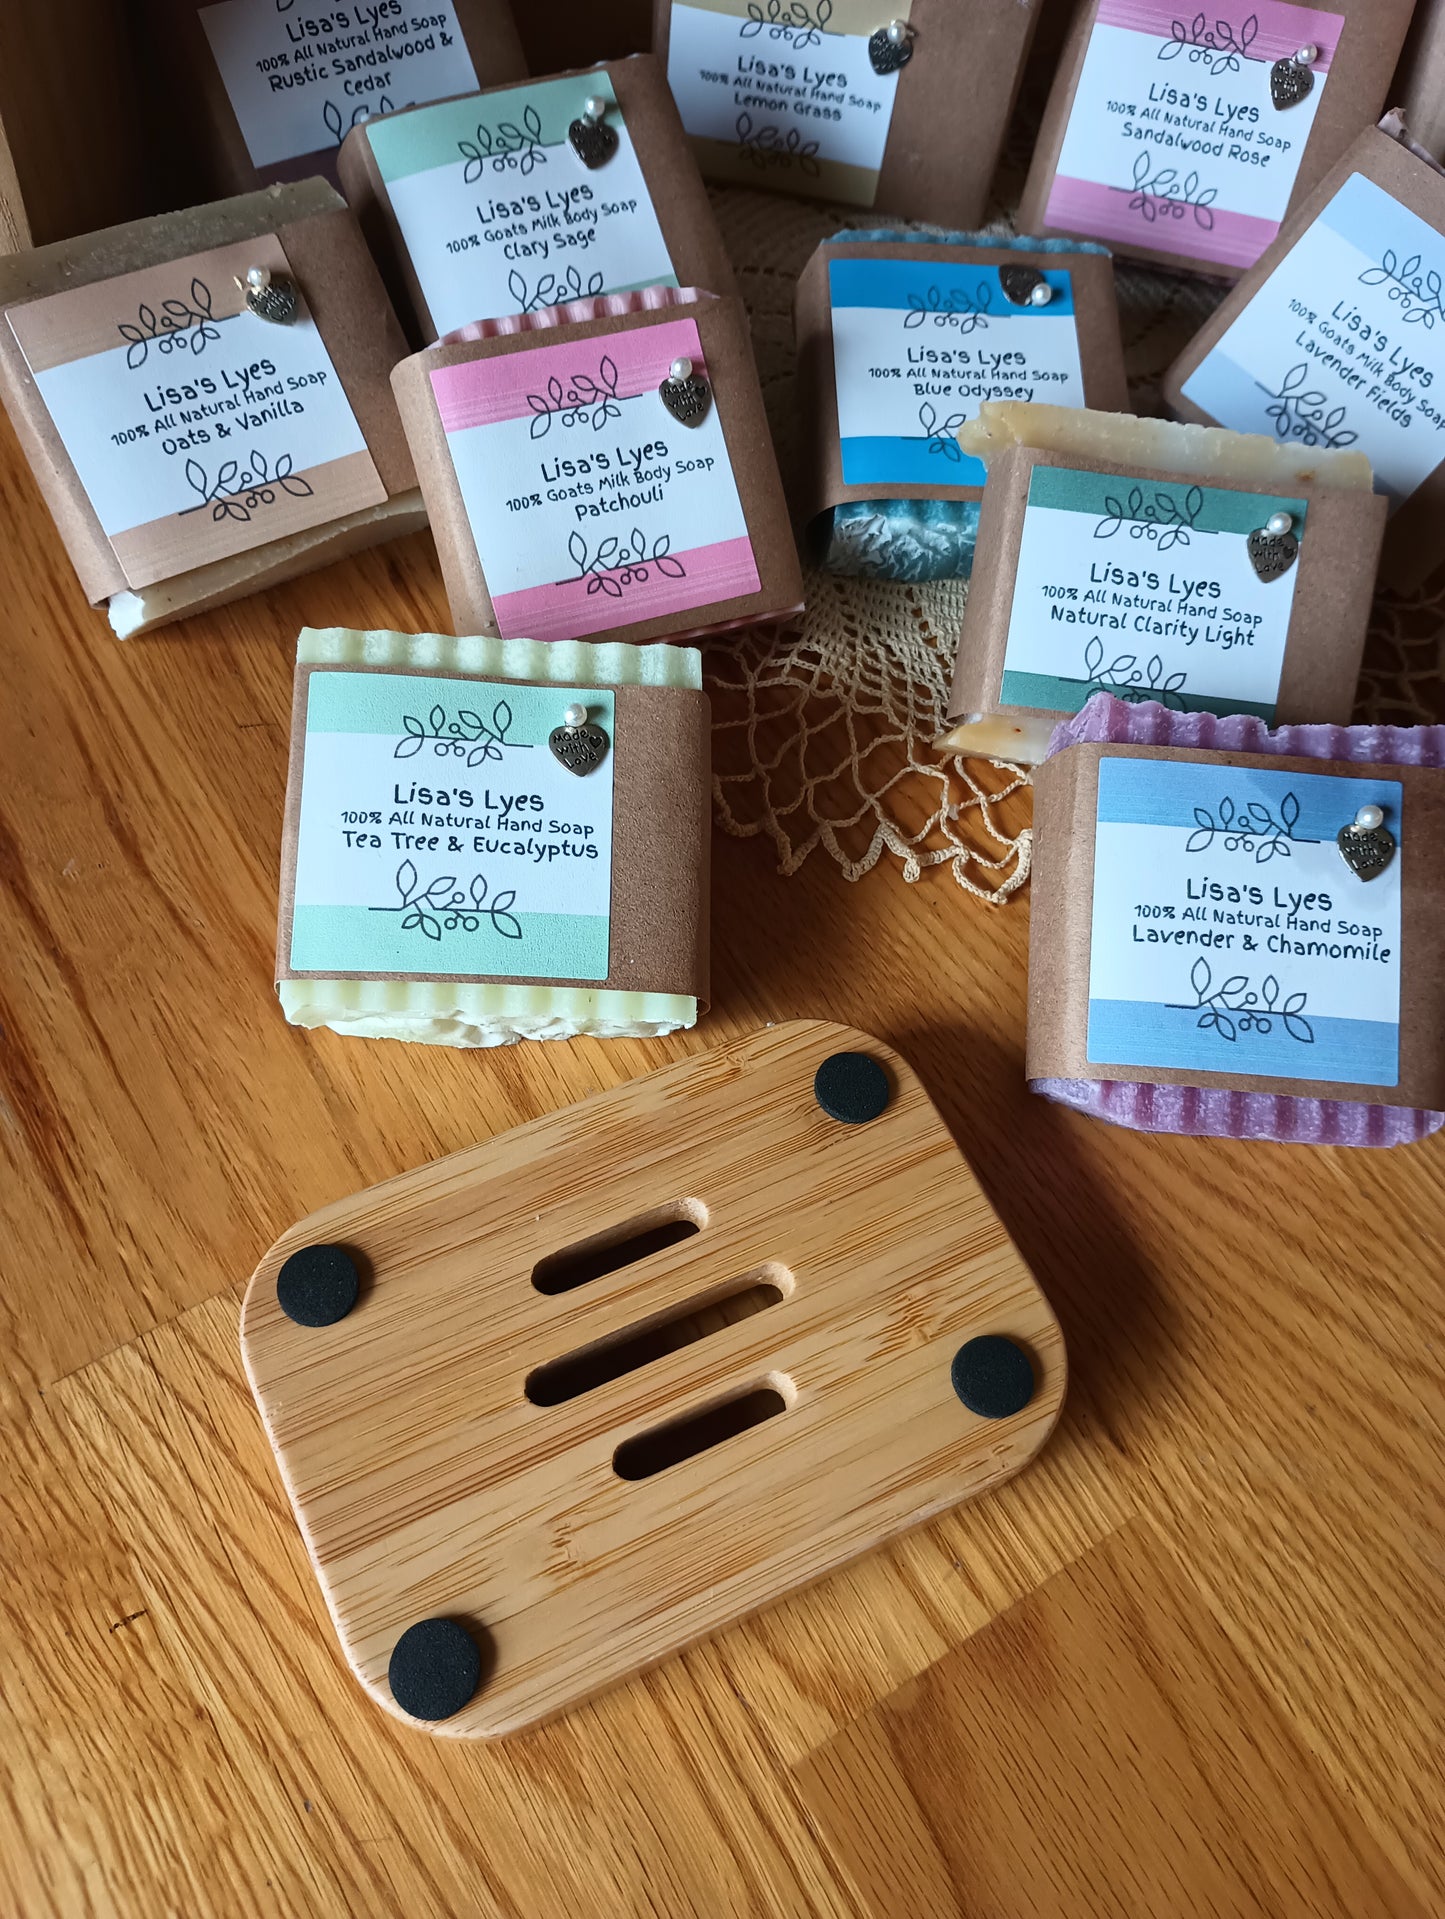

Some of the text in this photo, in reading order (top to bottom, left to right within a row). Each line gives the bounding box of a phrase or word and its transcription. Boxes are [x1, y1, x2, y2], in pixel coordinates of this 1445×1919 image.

[286, 0, 402, 42] Lisa's Lyes
[256, 14, 446, 72] 100% All Natural Hand Soap
[268, 32, 453, 92] Rustic Sandalwood &
[344, 72, 391, 96] Cedar
[738, 55, 848, 88] Lisa's Lyes
[700, 69, 882, 113] 100% All Natural Hand Soap
[734, 92, 842, 121] Lemon Grass
[1149, 83, 1259, 124] Lisa's Lyes
[1106, 101, 1291, 152] 100% All Natural Hand Soap
[1122, 122, 1271, 167] Sandalwood Rose
[477, 185, 593, 224] Lisa's Lyes
[446, 200, 637, 254] 100% Goats Milk Body Soap
[504, 228, 596, 260] Clary Sage
[907, 346, 1026, 369] Lisa's Lyes
[1288, 299, 1317, 324] 100%
[1318, 321, 1355, 355] Goats
[1356, 352, 1384, 378] Milk
[1384, 372, 1416, 405] Body
[1332, 301, 1433, 388] Lisa's Lyes
[143, 359, 276, 412] Lisa's Lyes
[664, 380, 695, 396] Made
[868, 368, 1069, 384] 100% All Natural Hand Soap
[914, 384, 1033, 402] Blue Odyssey
[1296, 331, 1412, 428] Lavender Fields
[111, 371, 327, 446] 100% All Natural Hand Soap
[162, 400, 304, 455] Oats & Vanilla
[677, 404, 703, 421] Love
[541, 441, 668, 483] Lisa's Lyes
[506, 457, 714, 512] 100% Goats Milk Body Soap
[575, 484, 663, 521] Patchouli
[1251, 536, 1284, 546] Made
[1090, 562, 1221, 601] Lisa's Lyes
[1255, 561, 1284, 574] Love
[1041, 585, 1262, 628] 100% All Natural Hand Soap
[1051, 605, 1255, 649] Natural Clarity Light
[553, 729, 590, 743] Made
[564, 752, 598, 769] Love
[394, 782, 544, 817] Lisa's Lyes
[341, 811, 594, 840] 100% All Natural Hand Soap
[342, 831, 598, 863] Tea Tree & Eucalyptus
[1187, 877, 1332, 915] Lisa's Lyes
[1134, 905, 1382, 941] 100% All Natural Hand Soap
[1133, 925, 1391, 963] Lavender & Chamomile
